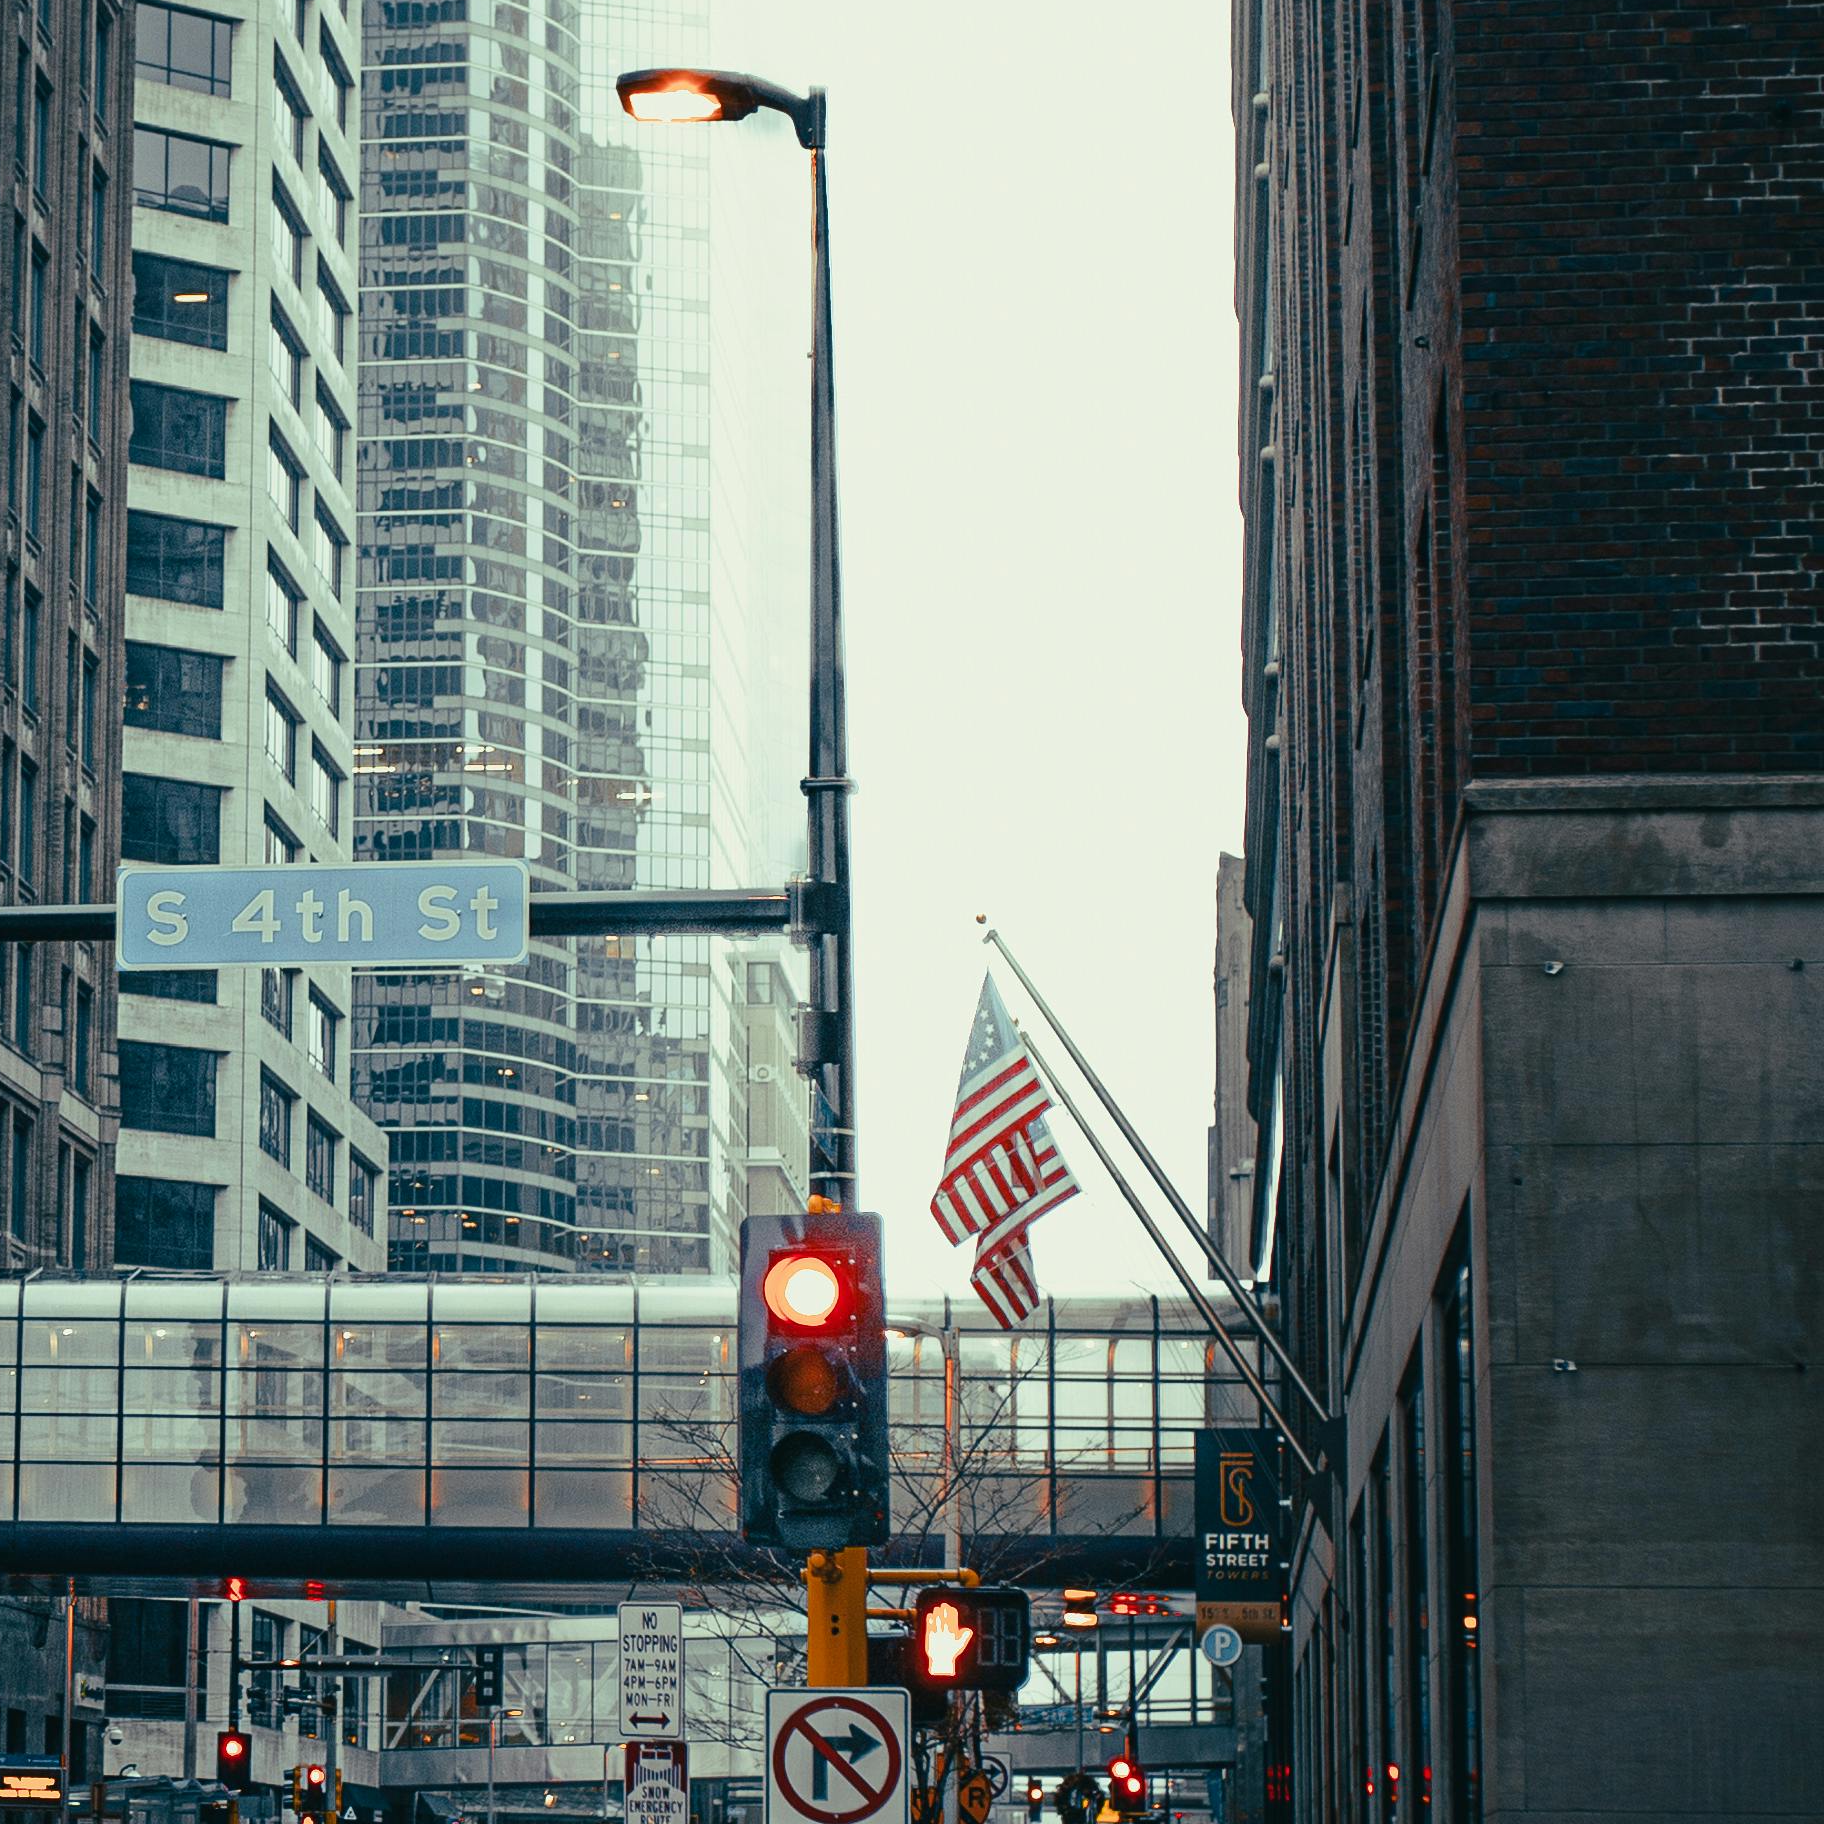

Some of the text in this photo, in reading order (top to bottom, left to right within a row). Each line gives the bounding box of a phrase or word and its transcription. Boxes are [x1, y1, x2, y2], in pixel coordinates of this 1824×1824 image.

[146, 884, 499, 946] S 4th St
[1204, 1533, 1270, 1550] FIFTH
[1206, 1553, 1269, 1567] STREET
[1206, 1570, 1271, 1581] TOWERS
[642, 1612, 657, 1630] NO
[623, 1635, 678, 1653] STOPPING
[1215, 1632, 1232, 1659] P
[641, 1786, 671, 1799] SNOW
[969, 1788, 985, 1808] R
[629, 1801, 684, 1814] EMERGENCY
